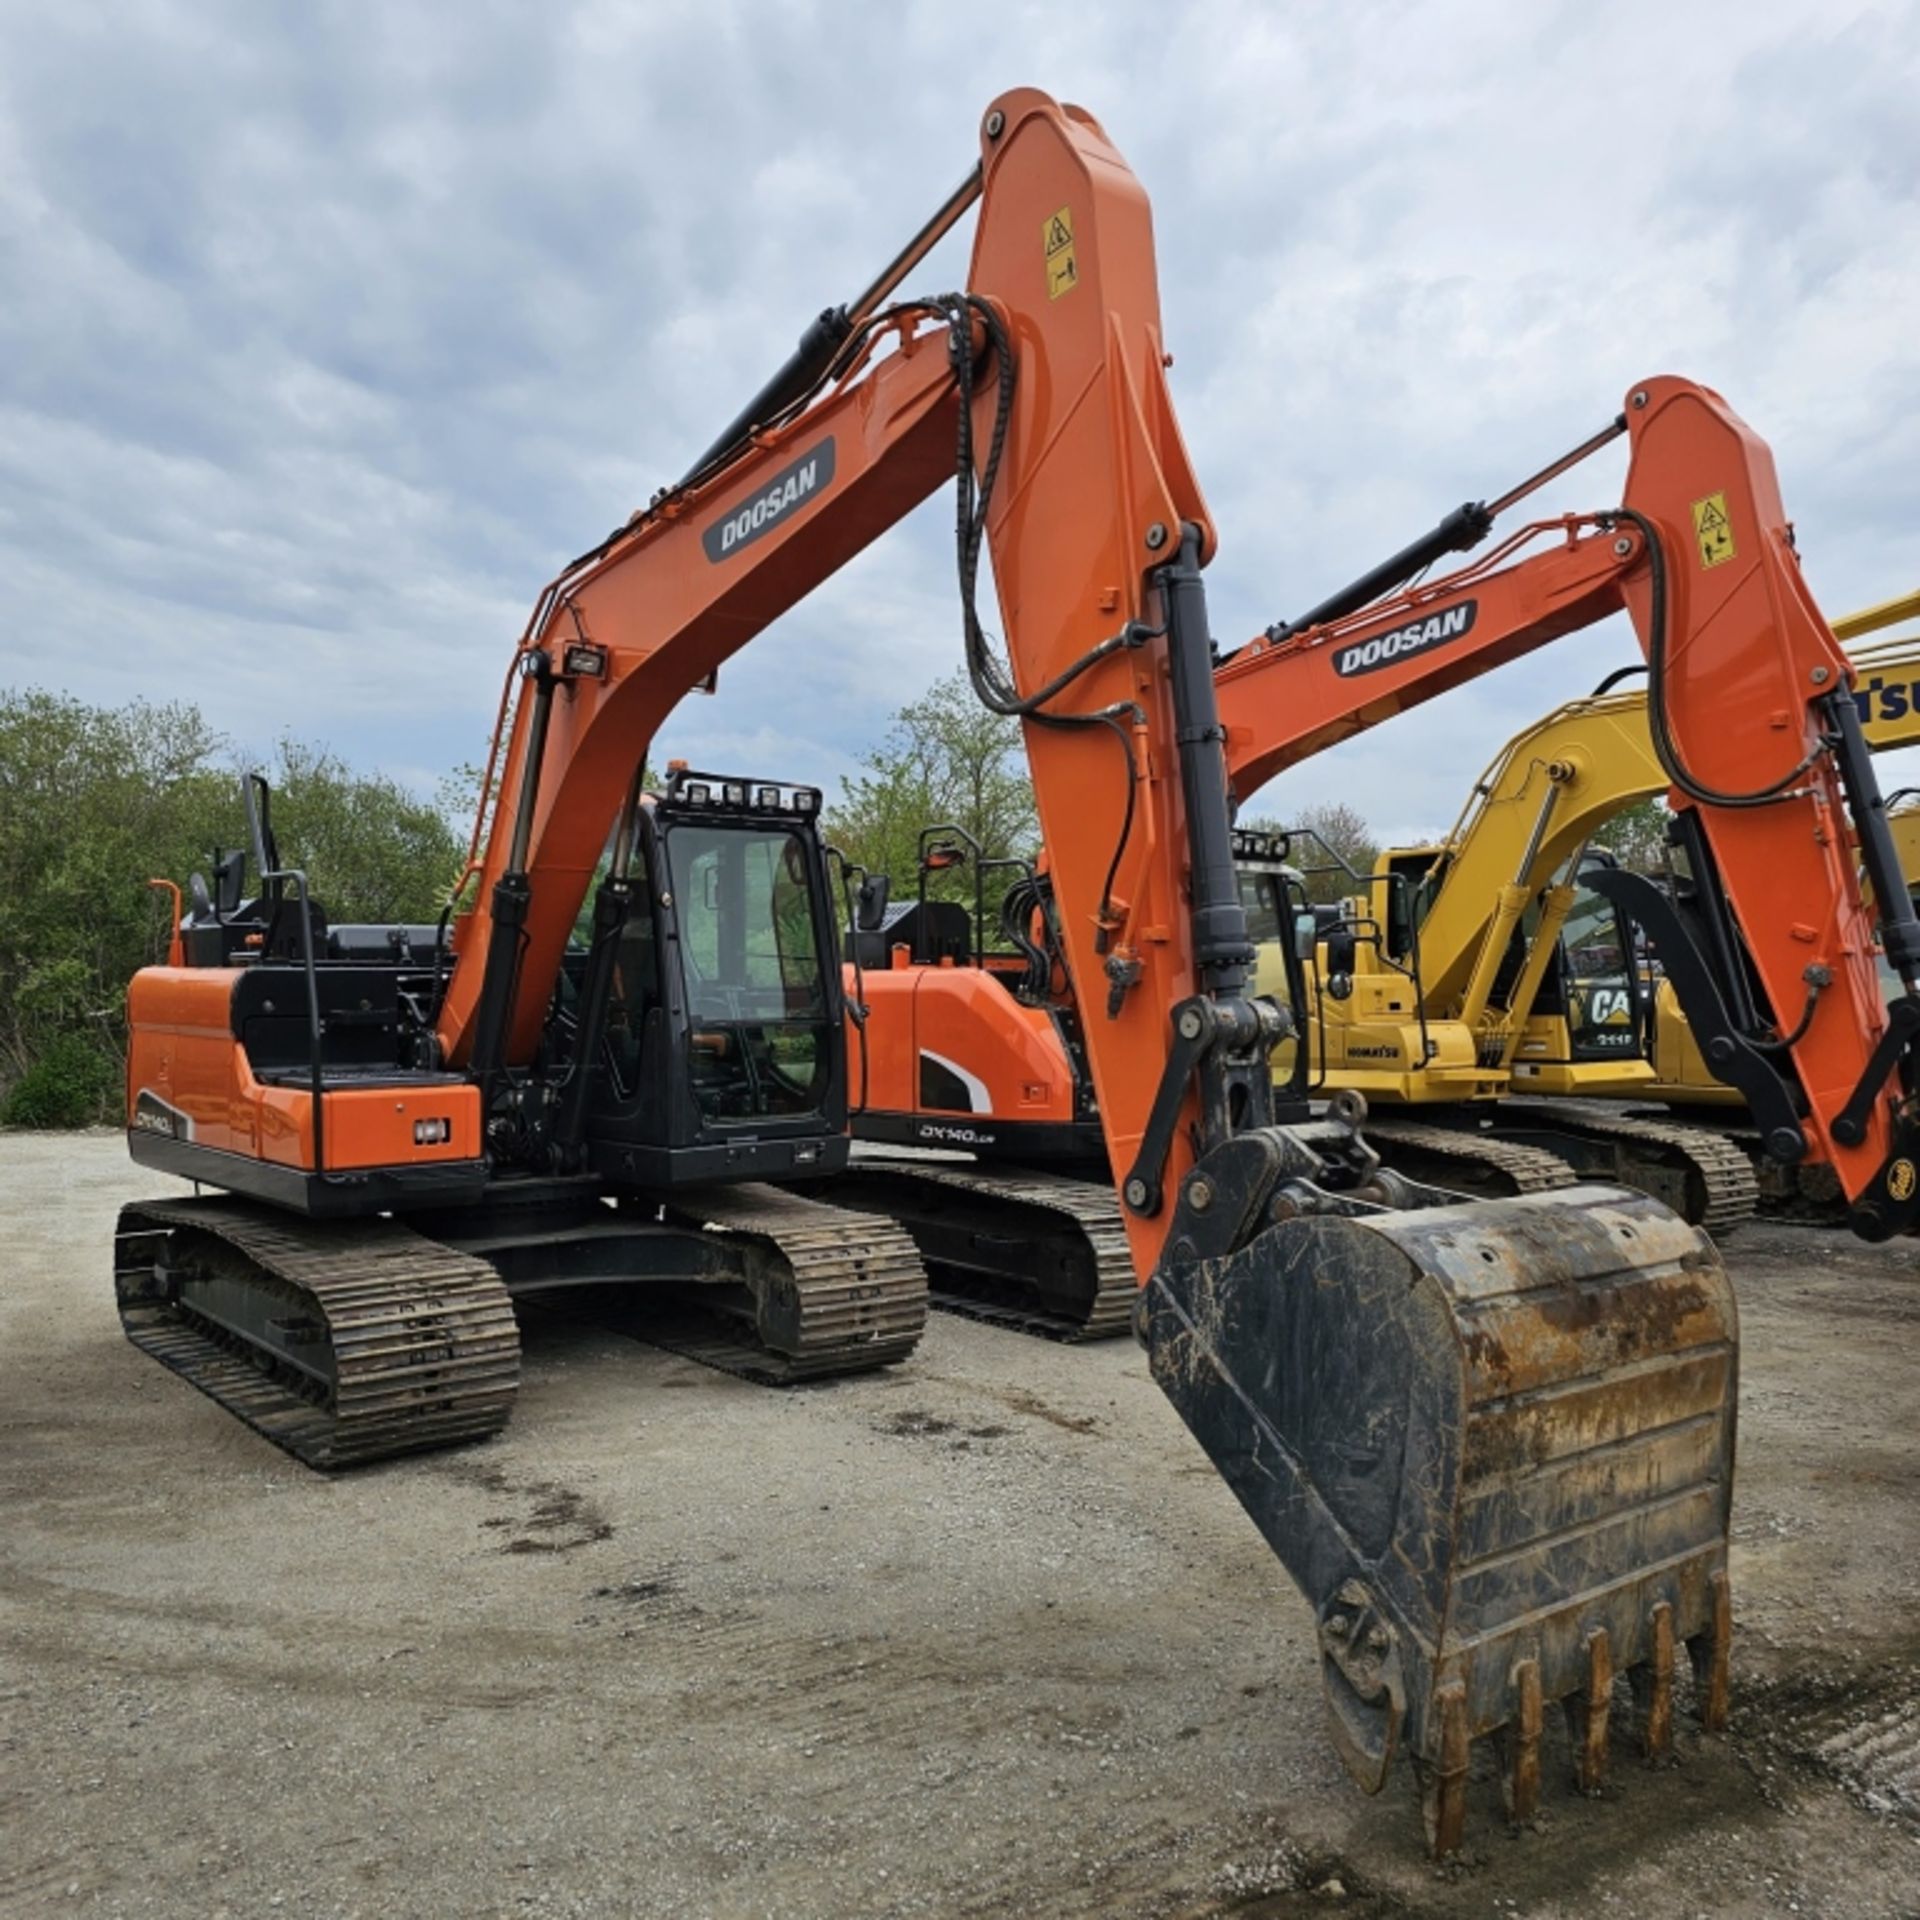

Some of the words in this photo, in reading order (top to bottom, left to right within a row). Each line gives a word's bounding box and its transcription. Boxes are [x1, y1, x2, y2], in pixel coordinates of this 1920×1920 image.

[721, 459, 817, 551] DOOSAN
[1341, 605, 1468, 675] DOOSAN
[1347, 1044, 1399, 1058] KOMATSU
